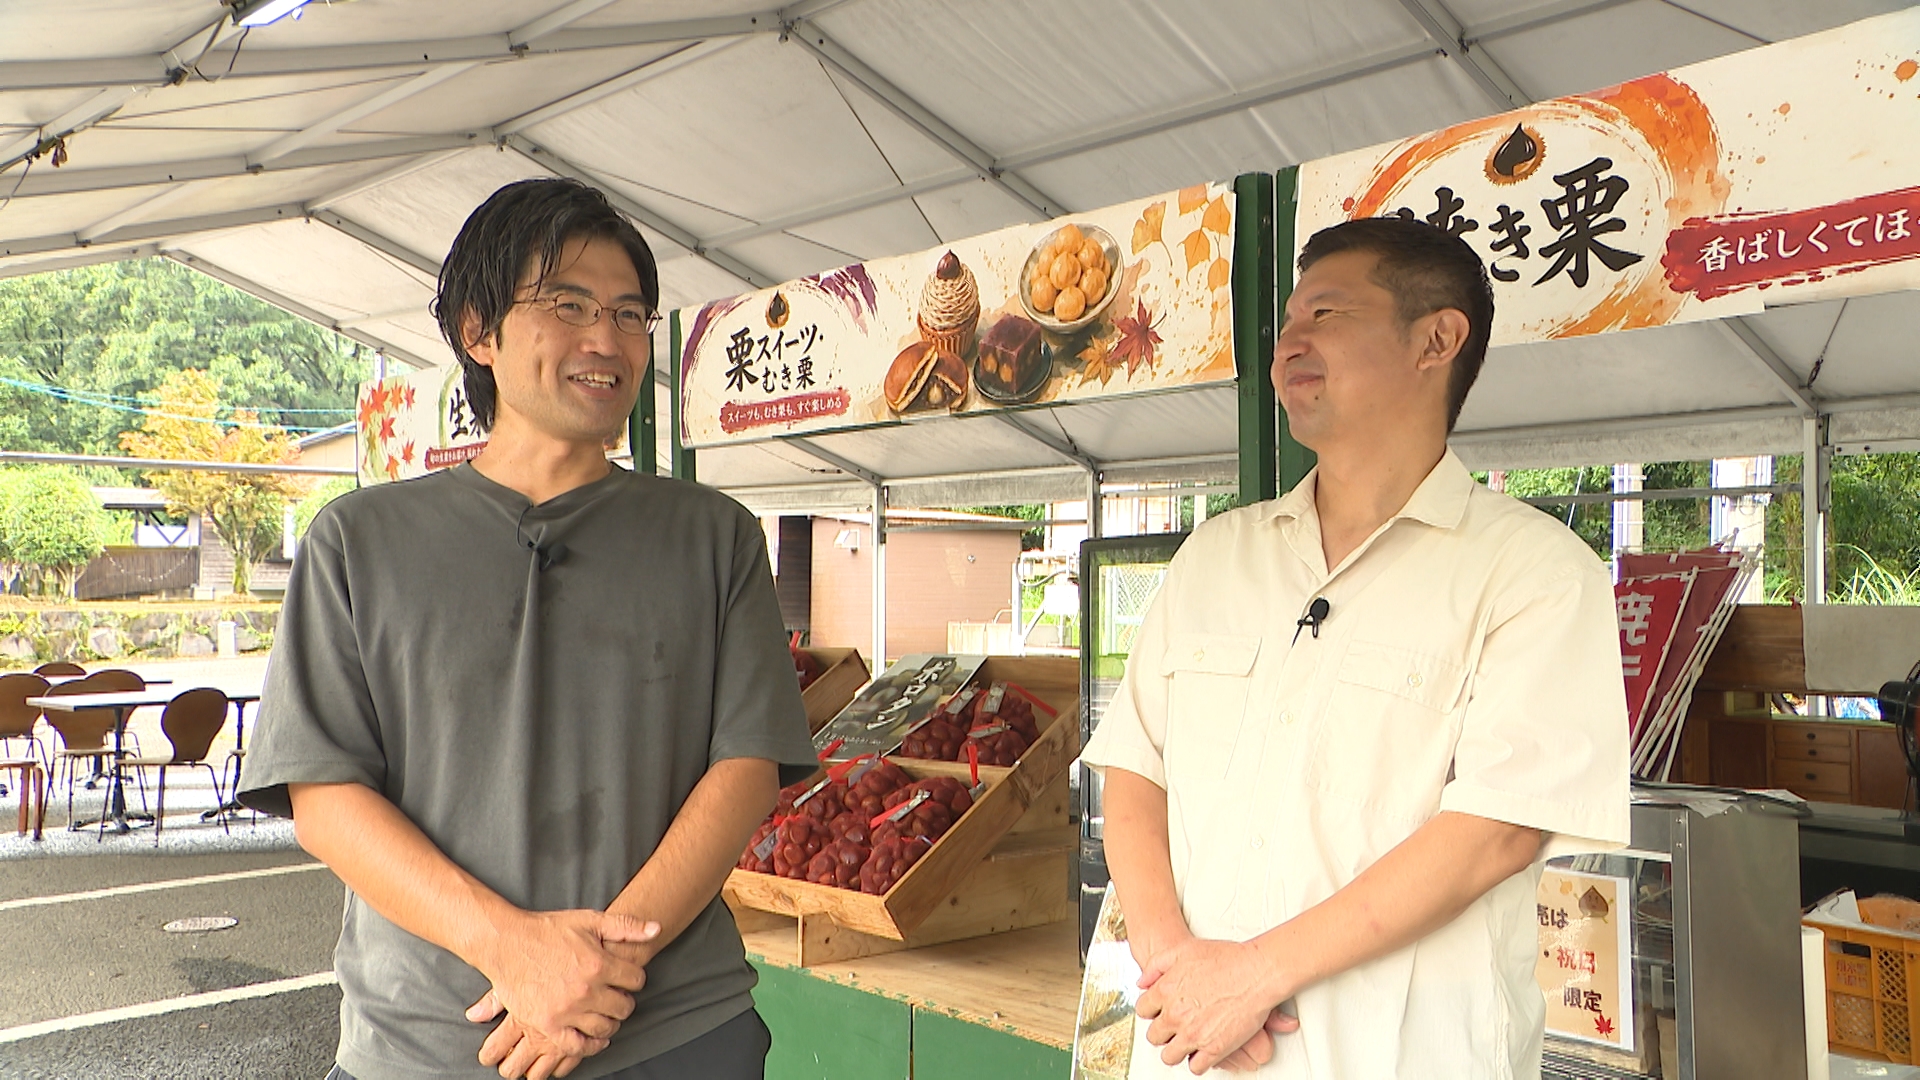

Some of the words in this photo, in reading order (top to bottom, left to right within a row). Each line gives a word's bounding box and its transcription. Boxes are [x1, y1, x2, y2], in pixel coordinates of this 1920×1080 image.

[1697, 208, 1920, 273] 香ばしくてほ
[762, 355, 816, 393] むき栗
[449, 387, 481, 440] 生
[1564, 986, 1602, 1012] 限定
